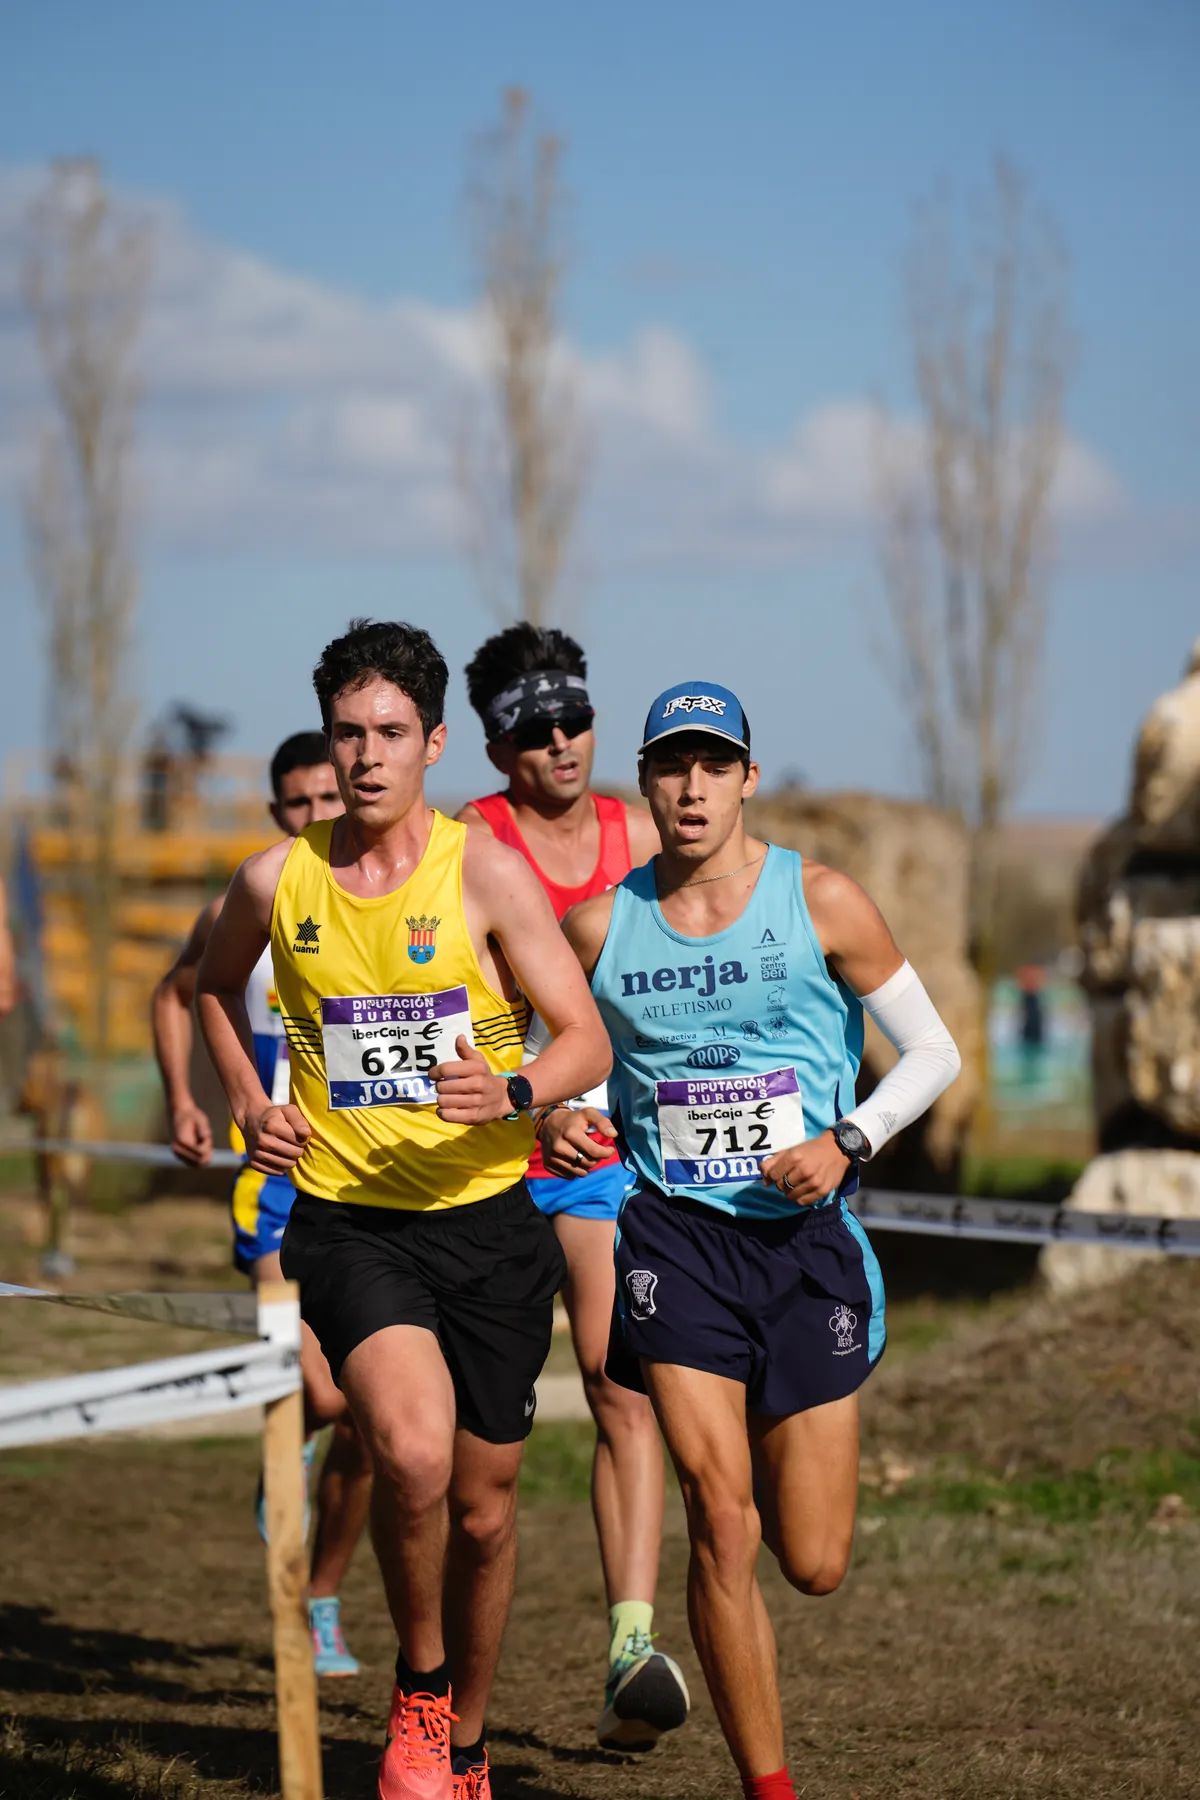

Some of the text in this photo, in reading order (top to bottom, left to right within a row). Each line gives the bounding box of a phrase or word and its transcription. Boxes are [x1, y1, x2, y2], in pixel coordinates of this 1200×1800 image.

[293, 944, 319, 954] luanvi
[621, 955, 748, 997] nerja
[352, 996, 434, 1011] DIPUTACIÓN
[642, 998, 732, 1020] ATLETISMO
[353, 1008, 435, 1023] BURGOS
[352, 1026, 410, 1041] iberCaja
[361, 1044, 438, 1077] 625
[688, 1046, 739, 1067] TROPS
[687, 1077, 767, 1093] DIPUTACIÓN
[688, 1088, 768, 1105] BURGOS
[687, 1107, 743, 1121] iberCaja
[695, 1124, 772, 1155] 712
[693, 1155, 773, 1184] Jom
